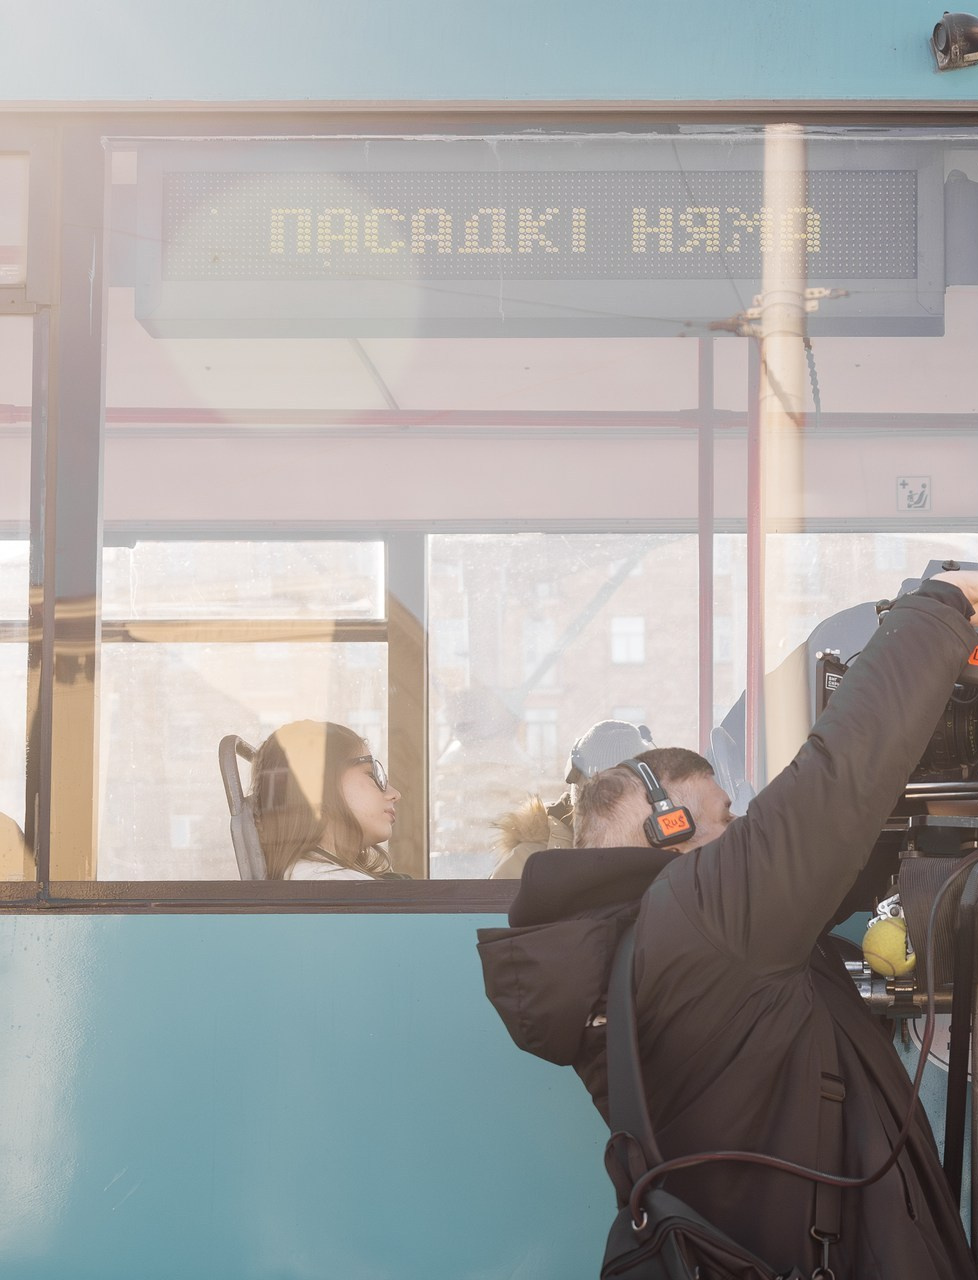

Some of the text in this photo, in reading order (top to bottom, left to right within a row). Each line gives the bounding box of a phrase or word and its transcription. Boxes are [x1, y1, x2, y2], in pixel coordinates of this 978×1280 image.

[270, 207, 822, 255] ПАСАДКІ НЯМА
[659, 801, 669, 811] 2
[662, 815, 686, 830] Rus
